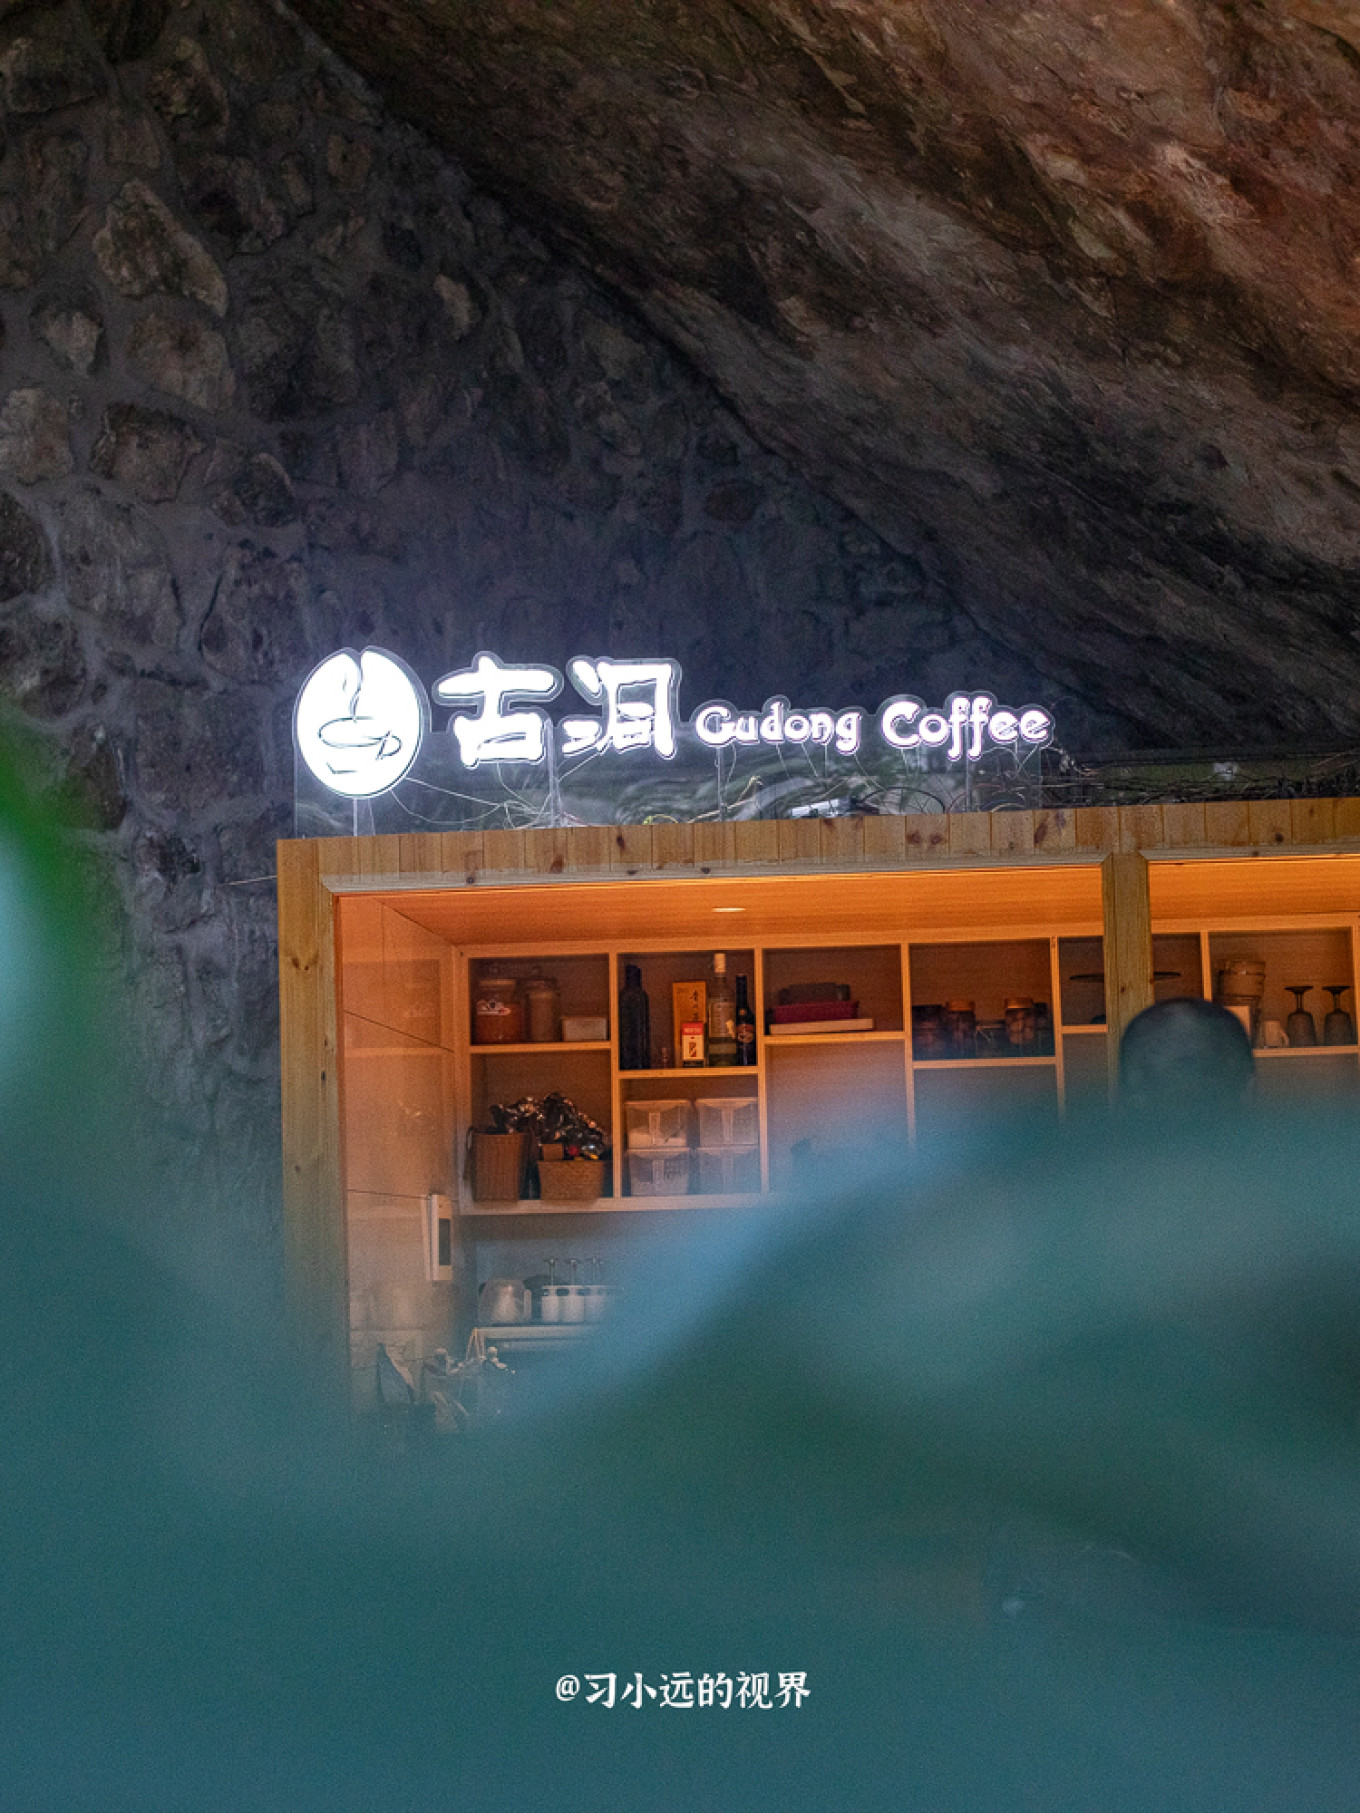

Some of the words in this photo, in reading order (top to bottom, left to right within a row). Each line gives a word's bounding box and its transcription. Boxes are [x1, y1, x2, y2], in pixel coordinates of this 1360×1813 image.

[437, 655, 676, 769] 古洞
[695, 702, 861, 755] Gudong
[881, 696, 1050, 761] Coffee
